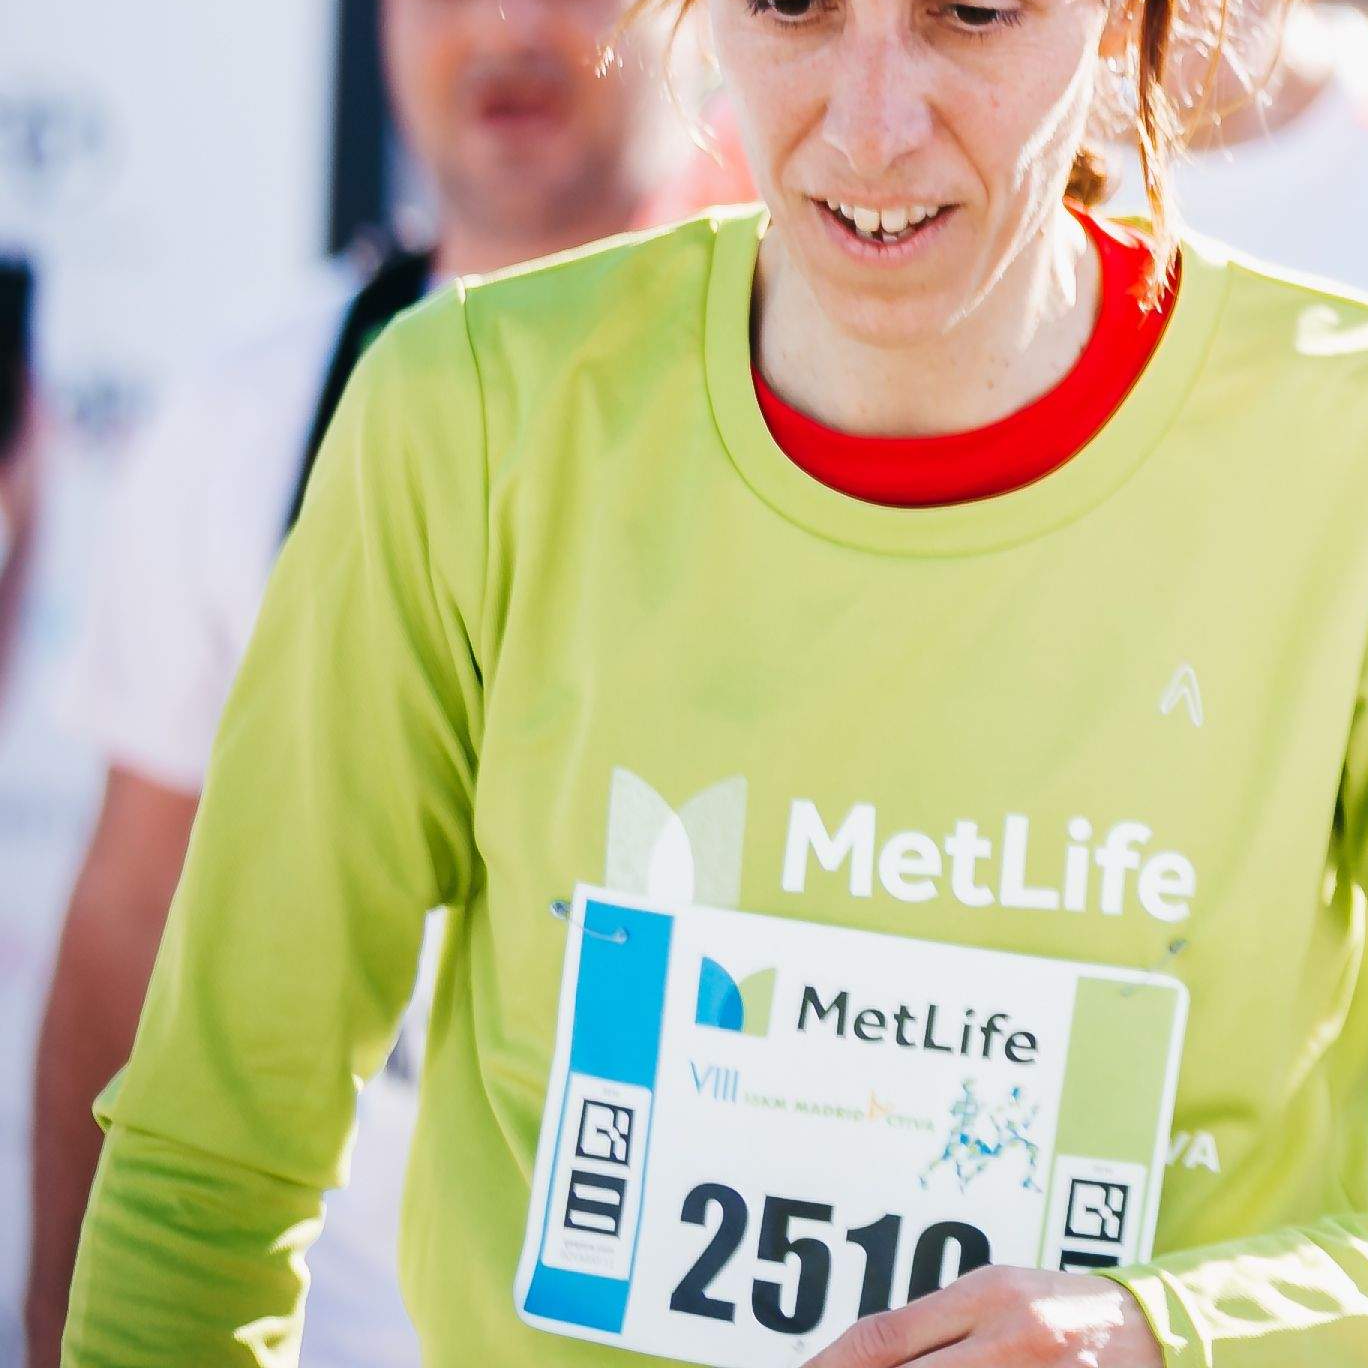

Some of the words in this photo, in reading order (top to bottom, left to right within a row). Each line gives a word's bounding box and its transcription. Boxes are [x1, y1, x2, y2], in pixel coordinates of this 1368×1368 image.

[781, 797, 1197, 923] MetLife
[796, 984, 1039, 1064] MetLife
[689, 1058, 741, 1104] VIII
